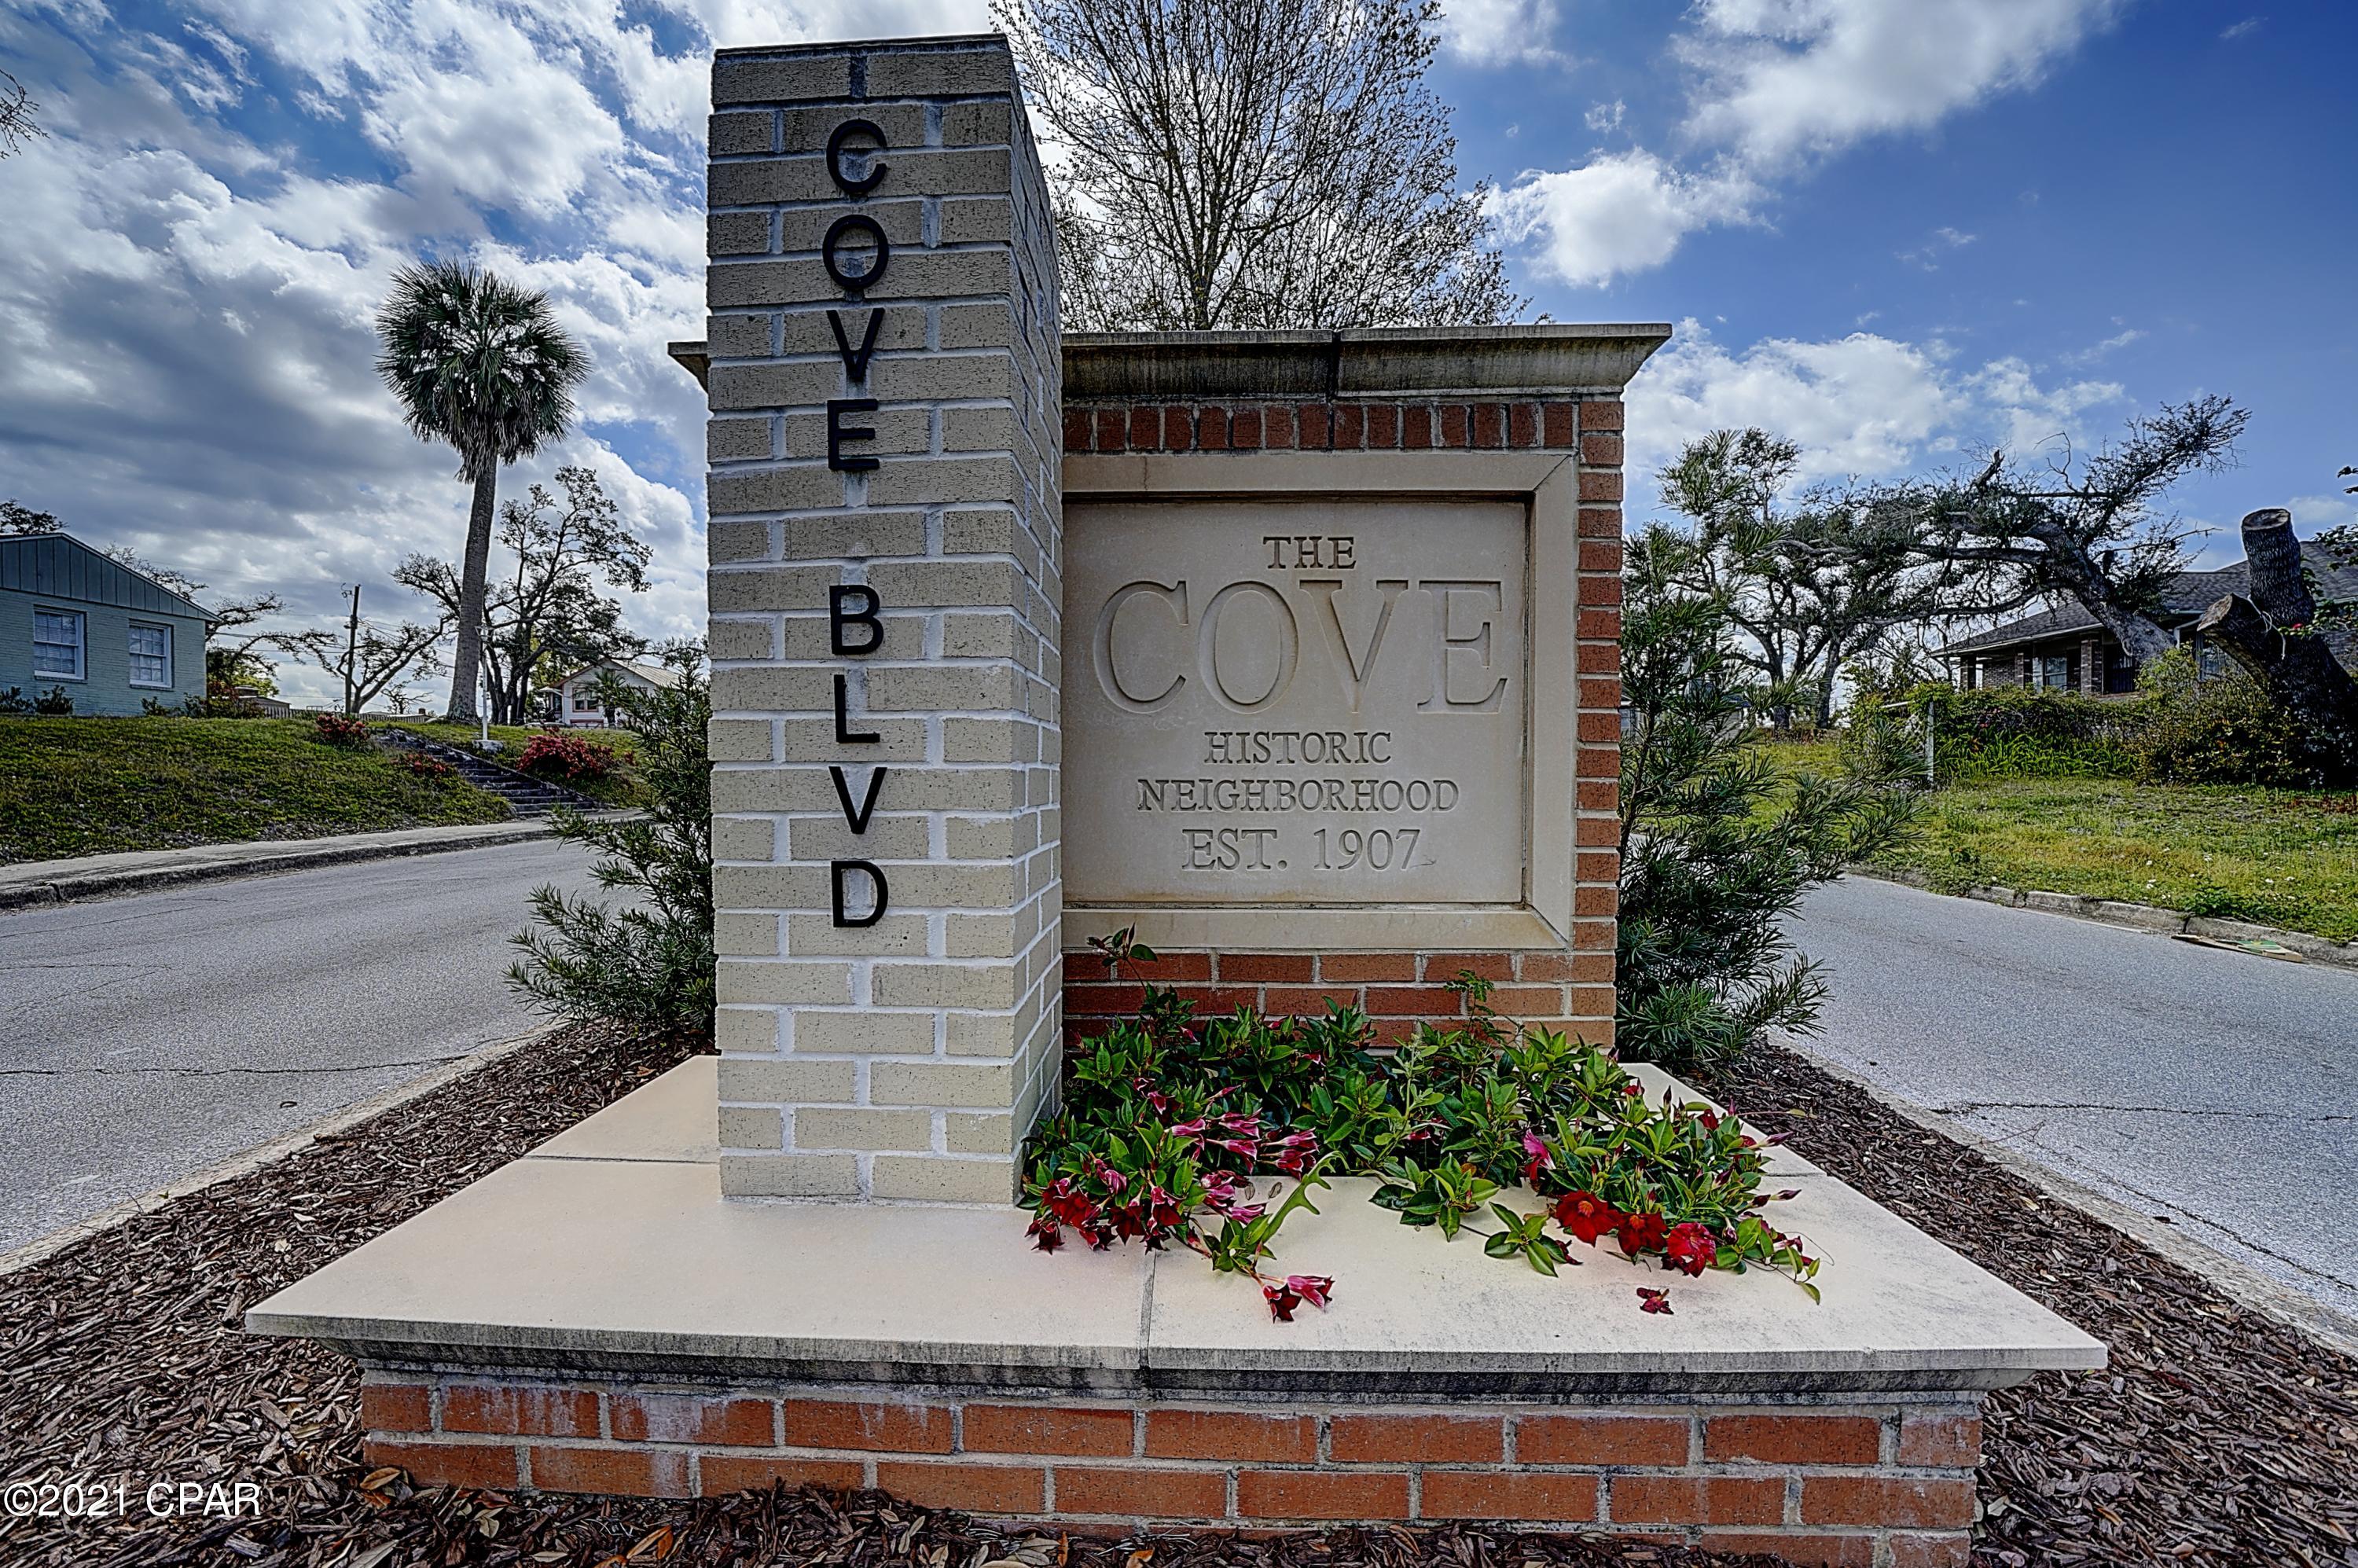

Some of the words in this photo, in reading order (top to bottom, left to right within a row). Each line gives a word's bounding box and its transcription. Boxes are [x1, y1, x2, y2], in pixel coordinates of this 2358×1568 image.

[821, 118, 890, 471] COVE
[1262, 535, 1357, 570] THE
[1093, 579, 1508, 714] COVE
[828, 584, 889, 928] BLVD
[1203, 731, 1393, 766] HISTORIC
[1137, 779, 1460, 813] NEIGHBORHOOD
[1181, 828, 1289, 872] EST.
[1312, 828, 1422, 872] 1907
